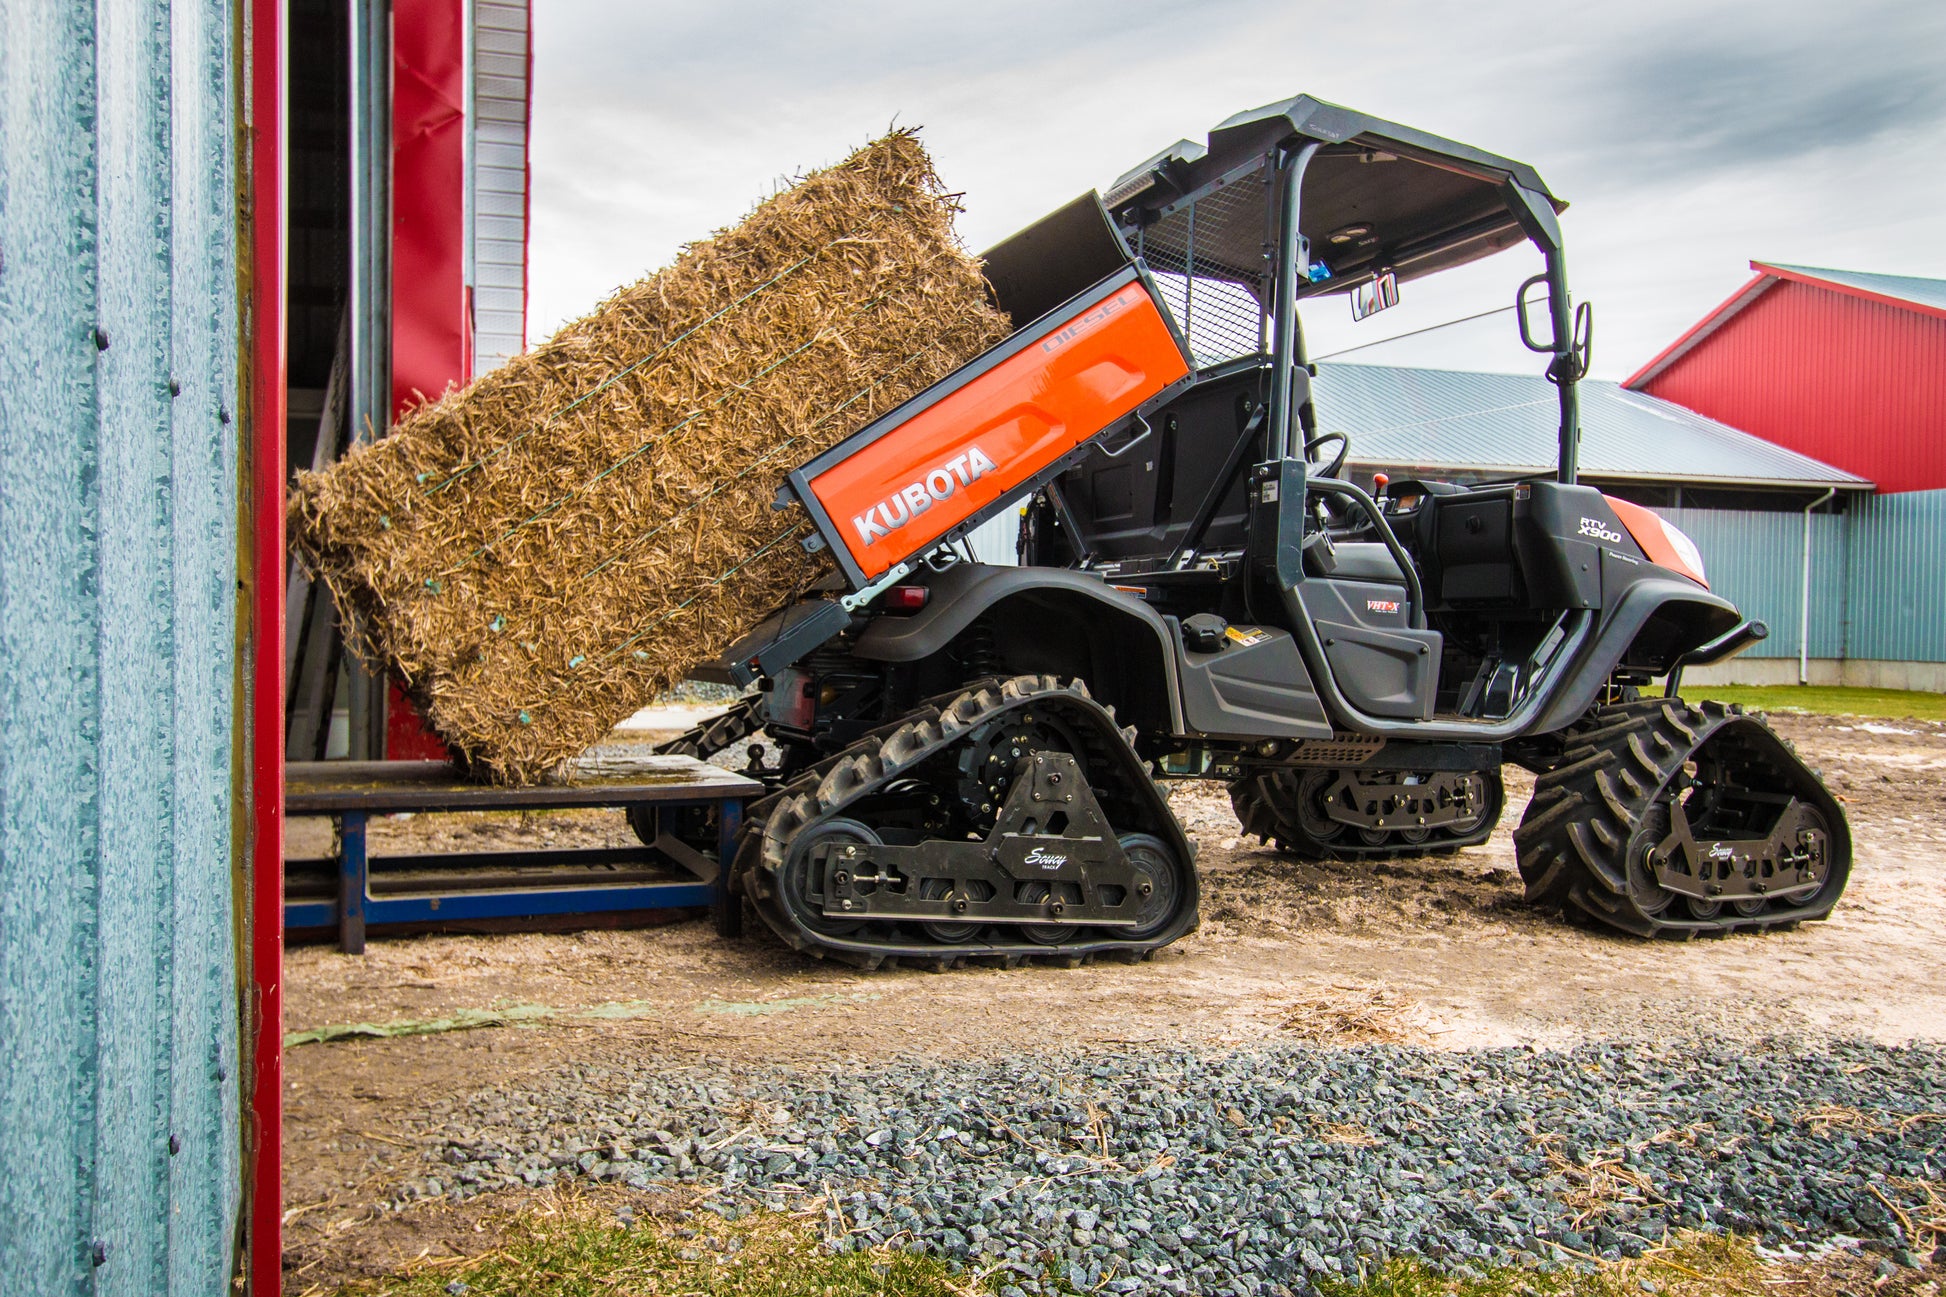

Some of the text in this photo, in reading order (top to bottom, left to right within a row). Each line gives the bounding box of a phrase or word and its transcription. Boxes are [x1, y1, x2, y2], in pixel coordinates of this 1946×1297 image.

[1042, 295, 1138, 353] DIESEL
[852, 447, 998, 547] KUBOTA
[1577, 525, 1622, 543] X900
[1580, 517, 1607, 530] RTV
[1024, 847, 1067, 870] Soucy
